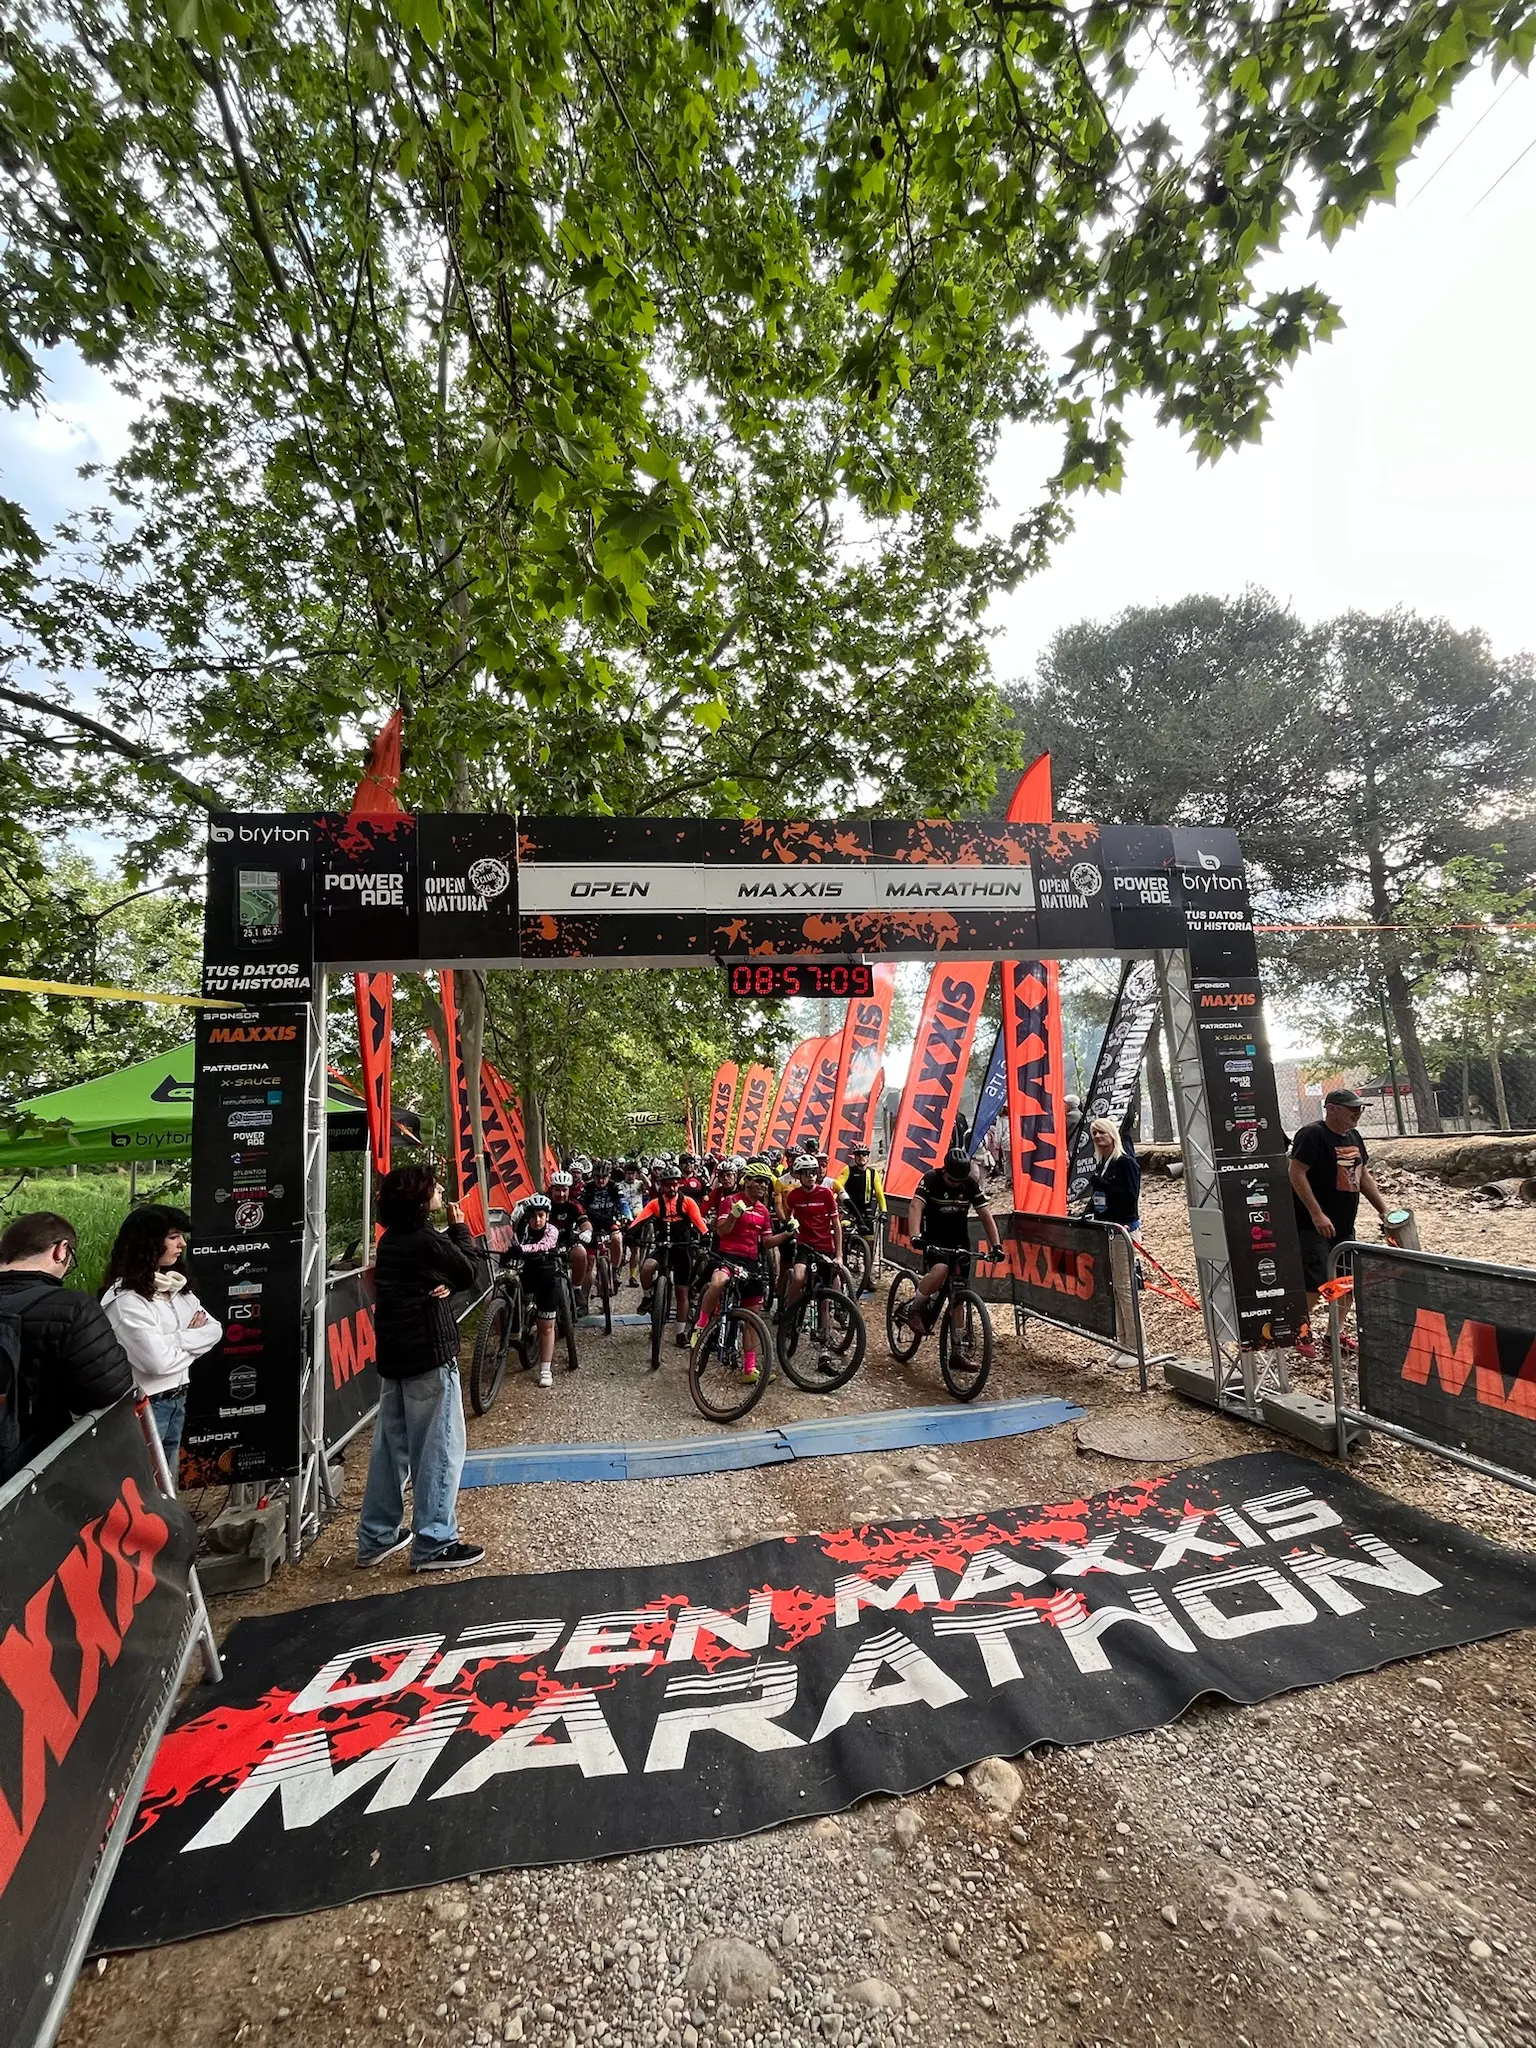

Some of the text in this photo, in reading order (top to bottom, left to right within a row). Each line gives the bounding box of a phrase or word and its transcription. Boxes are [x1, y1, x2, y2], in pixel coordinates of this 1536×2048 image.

[239, 825, 310, 844] bryton
[325, 874, 404, 890] POWER
[424, 877, 466, 894] OPEN
[1039, 878, 1070, 893] OPEN
[1113, 876, 1169, 891] POWER
[1182, 872, 1242, 893] bryton
[570, 882, 1021, 898] OPEN MAXXIS MARATHON
[1140, 890, 1170, 904] ADE
[361, 890, 404, 906] ADE
[424, 895, 489, 912] NATURA
[1041, 894, 1089, 909] NATURA
[1184, 911, 1244, 920] TUS DATOS
[1186, 922, 1252, 931] TU HISTORIA
[205, 964, 299, 977] TUS DATOS
[204, 977, 311, 991] TU HISTORIA
[733, 966, 869, 995] 08:57:09
[1194, 982, 1231, 990] SPONSOR
[1200, 994, 1257, 1007] MAXXIS
[203, 1012, 260, 1021] SPONSOR
[208, 1026, 298, 1043] MAXXIS
[202, 1063, 269, 1073] PATROCINA
[902, 976, 975, 1173] MAXXIS
[220, 1077, 282, 1087] X-SAUCE
[233, 1132, 265, 1141] POWER
[247, 1138, 265, 1146] ADE
[1221, 1163, 1269, 1172] COLLABORA
[192, 1243, 270, 1255] COLLABORA
[975, 1239, 1095, 1301] MAXXIS
[1241, 1309, 1272, 1318] SUPORT
[327, 1303, 377, 1391] MA
[188, 1432, 240, 1444] SUPORT
[286, 1486, 1343, 1714] OPEN MAXXIS
[180, 1531, 1442, 1854] MARATHON
